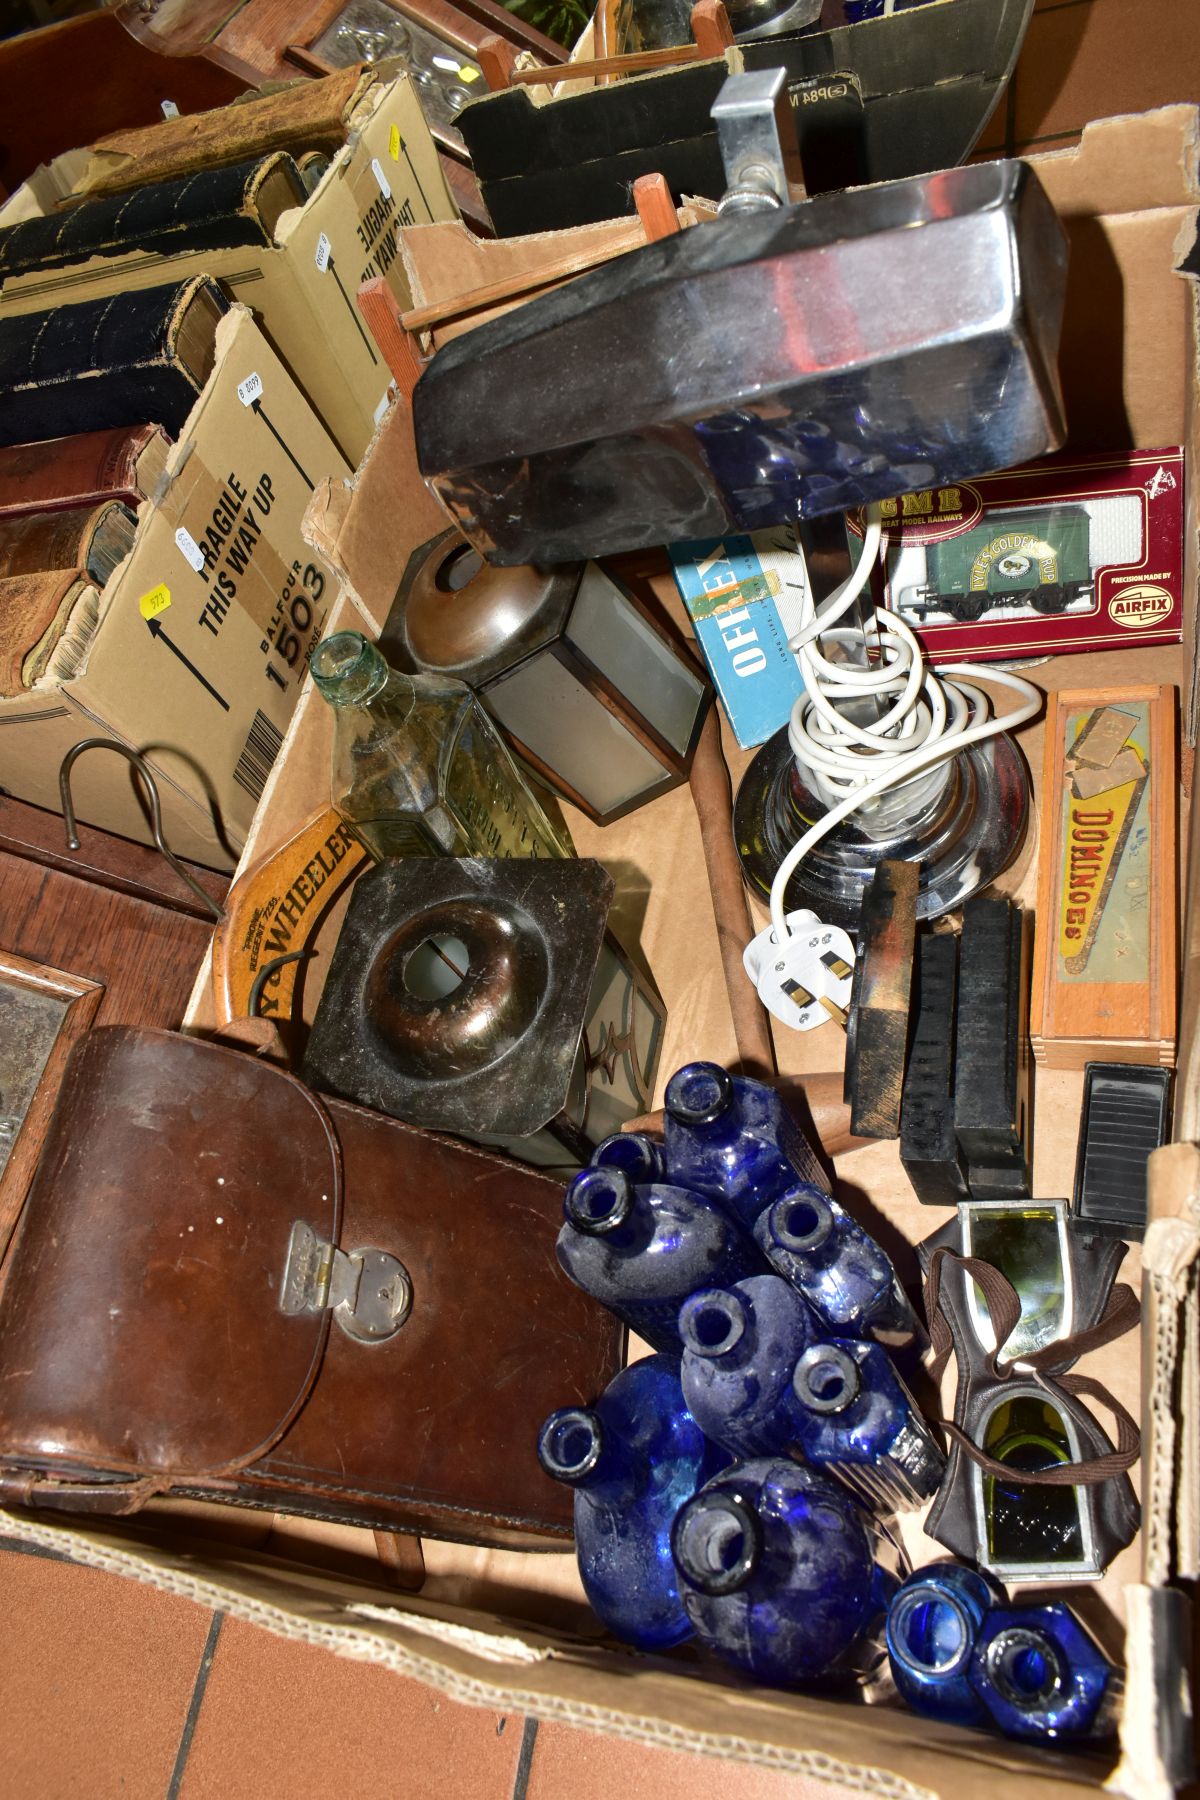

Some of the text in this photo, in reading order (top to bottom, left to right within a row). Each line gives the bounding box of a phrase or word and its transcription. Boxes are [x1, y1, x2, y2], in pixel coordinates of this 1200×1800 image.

[199, 473, 276, 637] THIS WAY UP
[881, 513, 963, 528] REAT MODEL RAILWAYS
[259, 559, 302, 655] BALFOUR
[1111, 571, 1172, 584] PRECISION MADE BY
[1114, 598, 1168, 615] AIRFIX
[264, 562, 325, 692] 1503
[1065, 808, 1115, 941] DOMINOES
